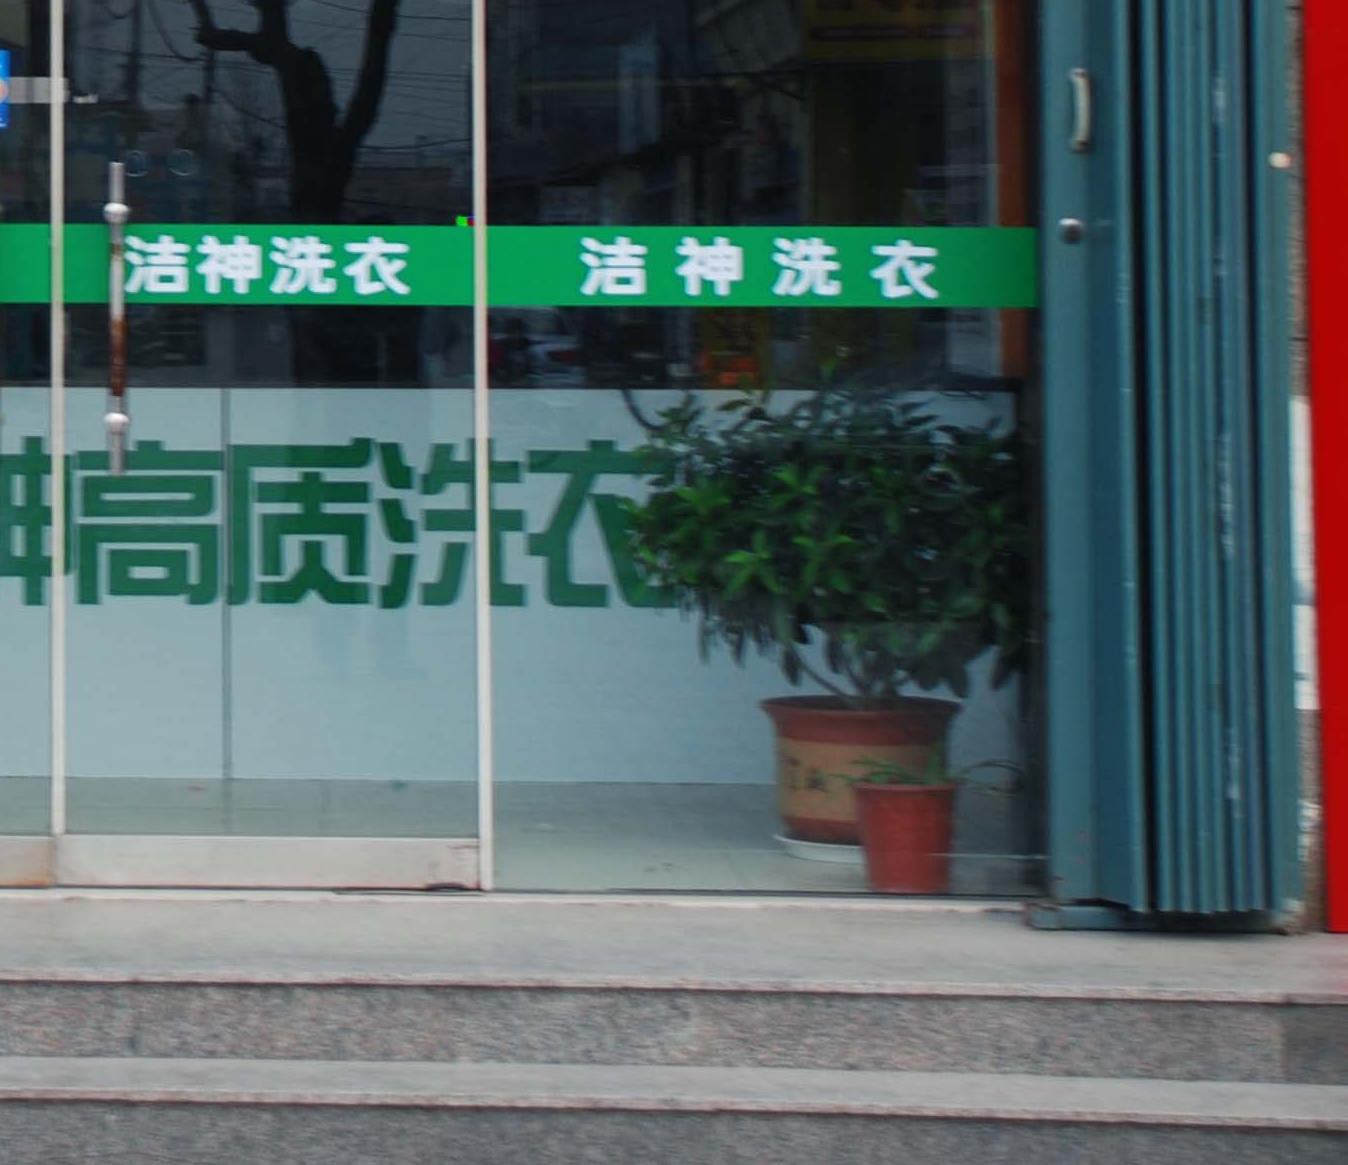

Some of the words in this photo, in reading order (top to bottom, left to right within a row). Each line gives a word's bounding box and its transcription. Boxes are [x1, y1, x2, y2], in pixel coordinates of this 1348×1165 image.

[123, 234, 411, 296] 洁神洗衣
[580, 236, 939, 299] 洁神洗衣
